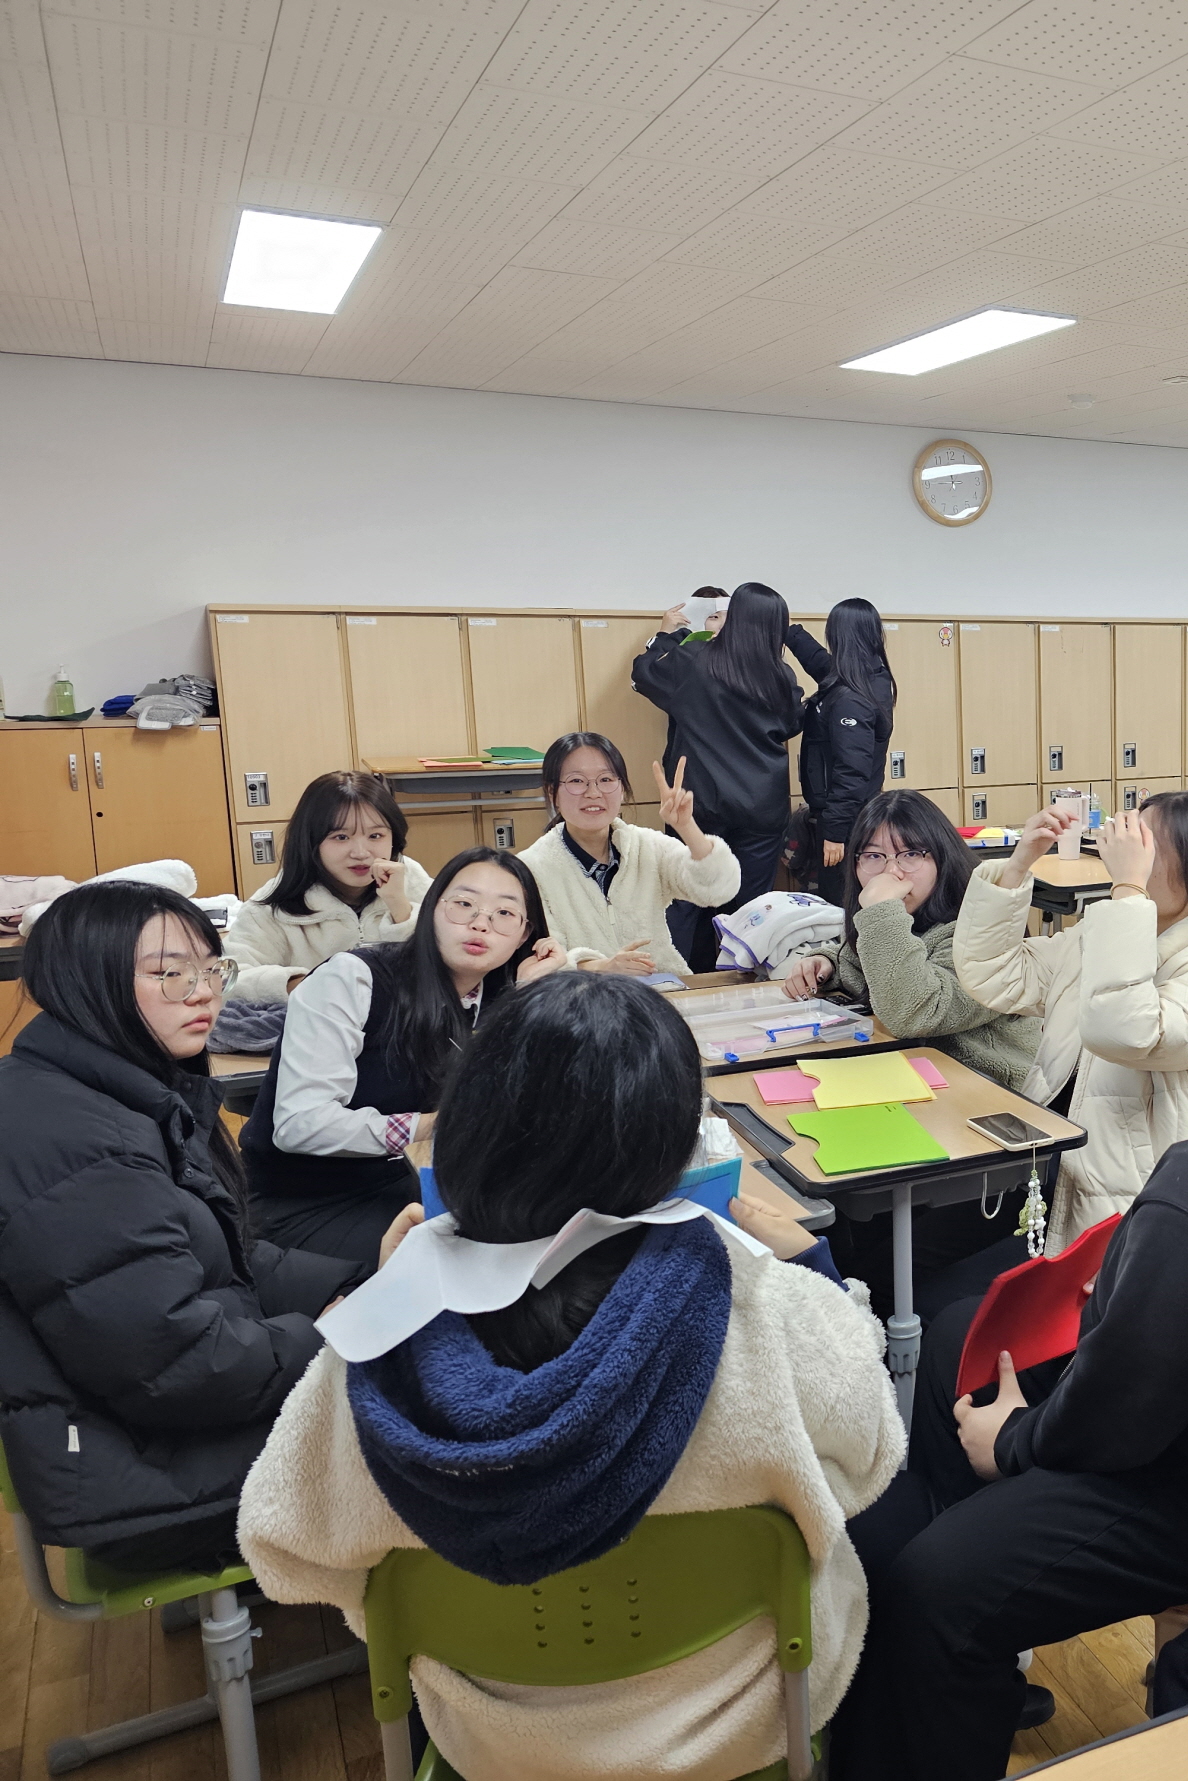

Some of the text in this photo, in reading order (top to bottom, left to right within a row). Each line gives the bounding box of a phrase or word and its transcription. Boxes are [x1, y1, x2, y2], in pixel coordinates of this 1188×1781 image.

[946, 451, 955, 460] 12
[935, 456, 941, 465] 11
[925, 481, 930, 489] 9
[975, 477, 980, 486] 3
[931, 495, 936, 503] 8
[973, 492, 977, 500] 4
[941, 503, 946, 512] 7
[953, 505, 958, 514] 6
